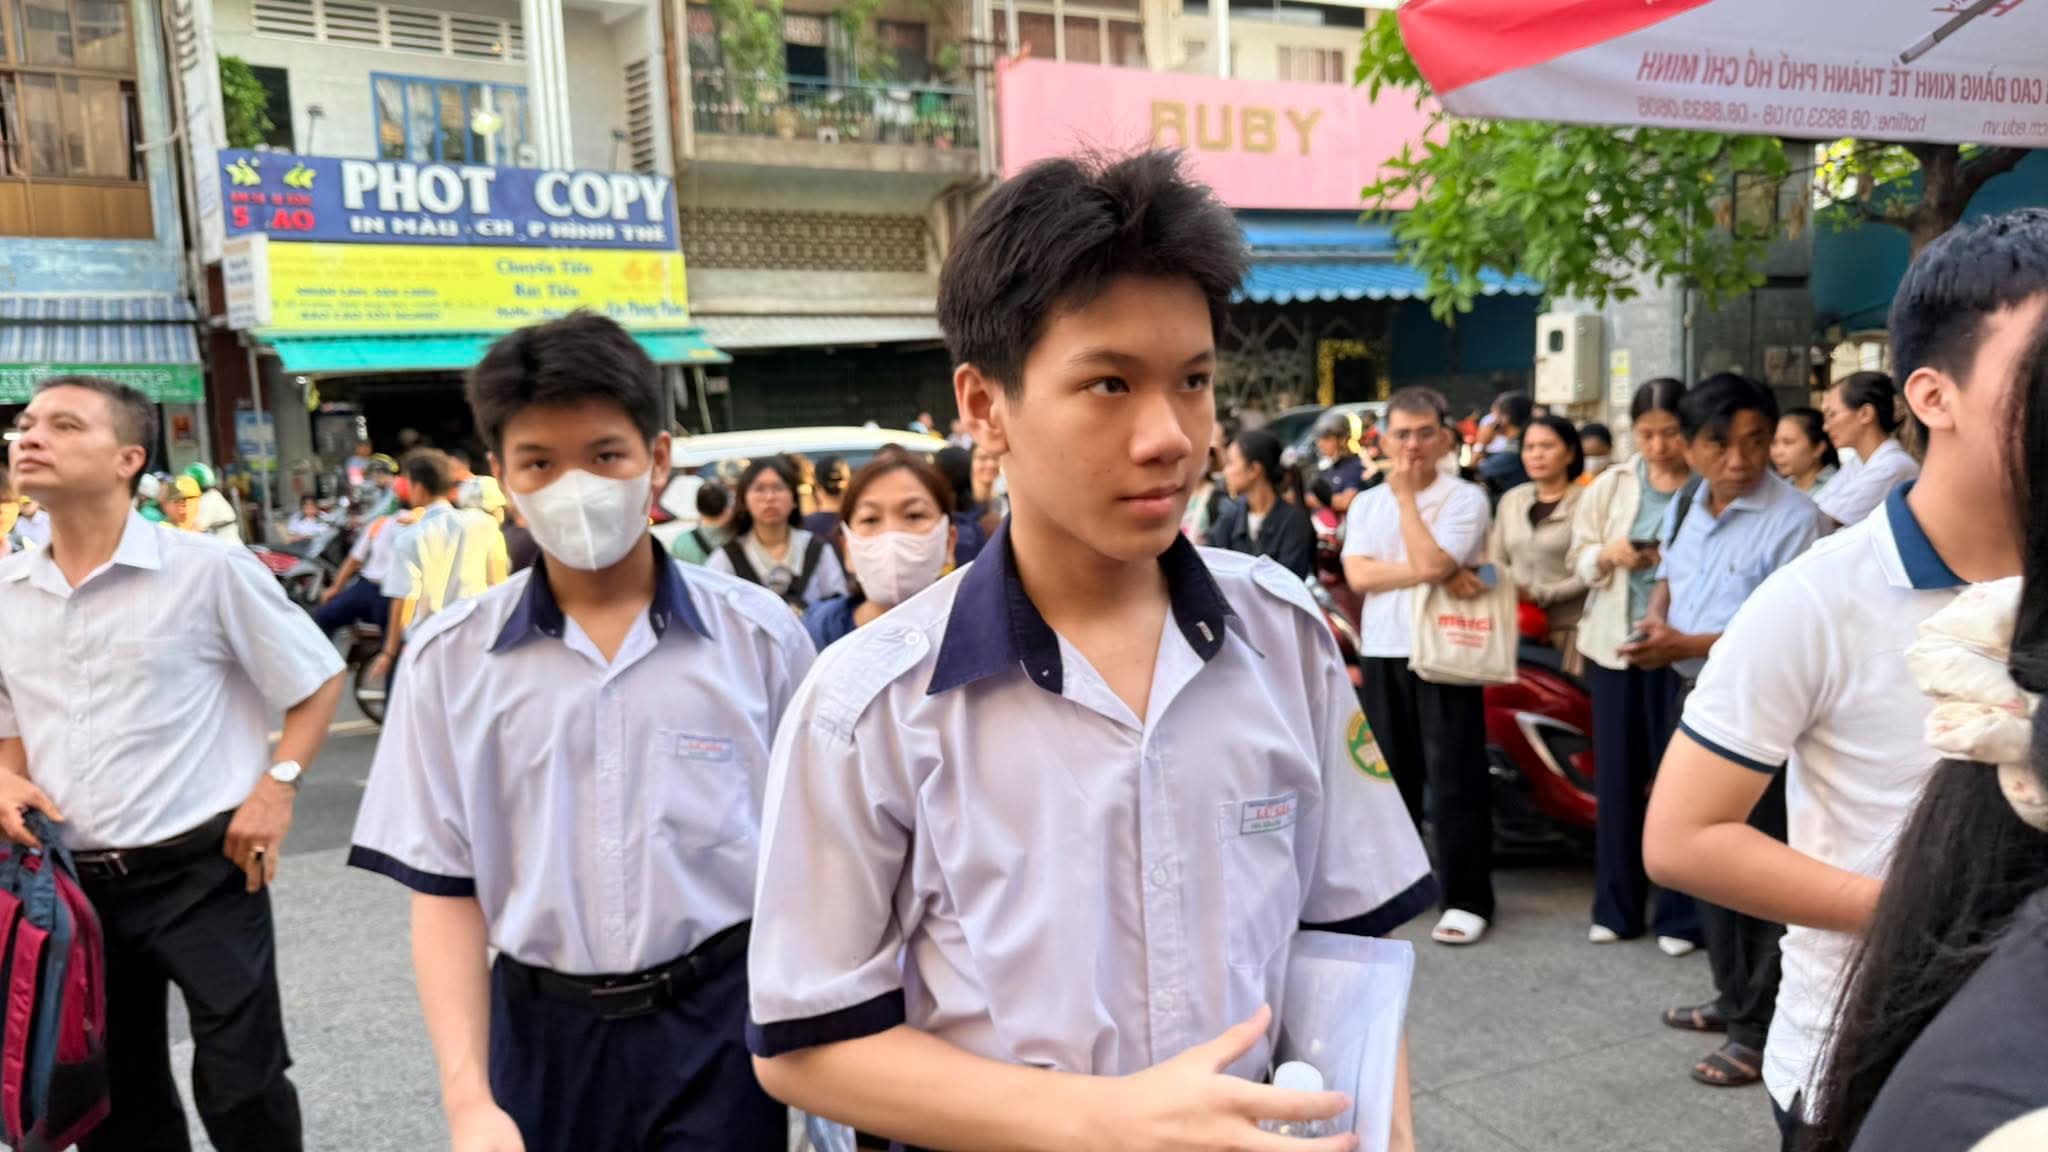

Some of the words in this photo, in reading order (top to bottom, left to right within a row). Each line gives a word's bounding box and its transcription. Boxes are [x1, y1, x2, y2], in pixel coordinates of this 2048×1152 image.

[1152, 100, 1324, 155] RUBY
[341, 160, 496, 214] PHOT
[535, 171, 669, 222] COPY
[351, 215, 385, 234] IN
[392, 213, 459, 237] MÀU
[550, 216, 616, 240] HÌNH
